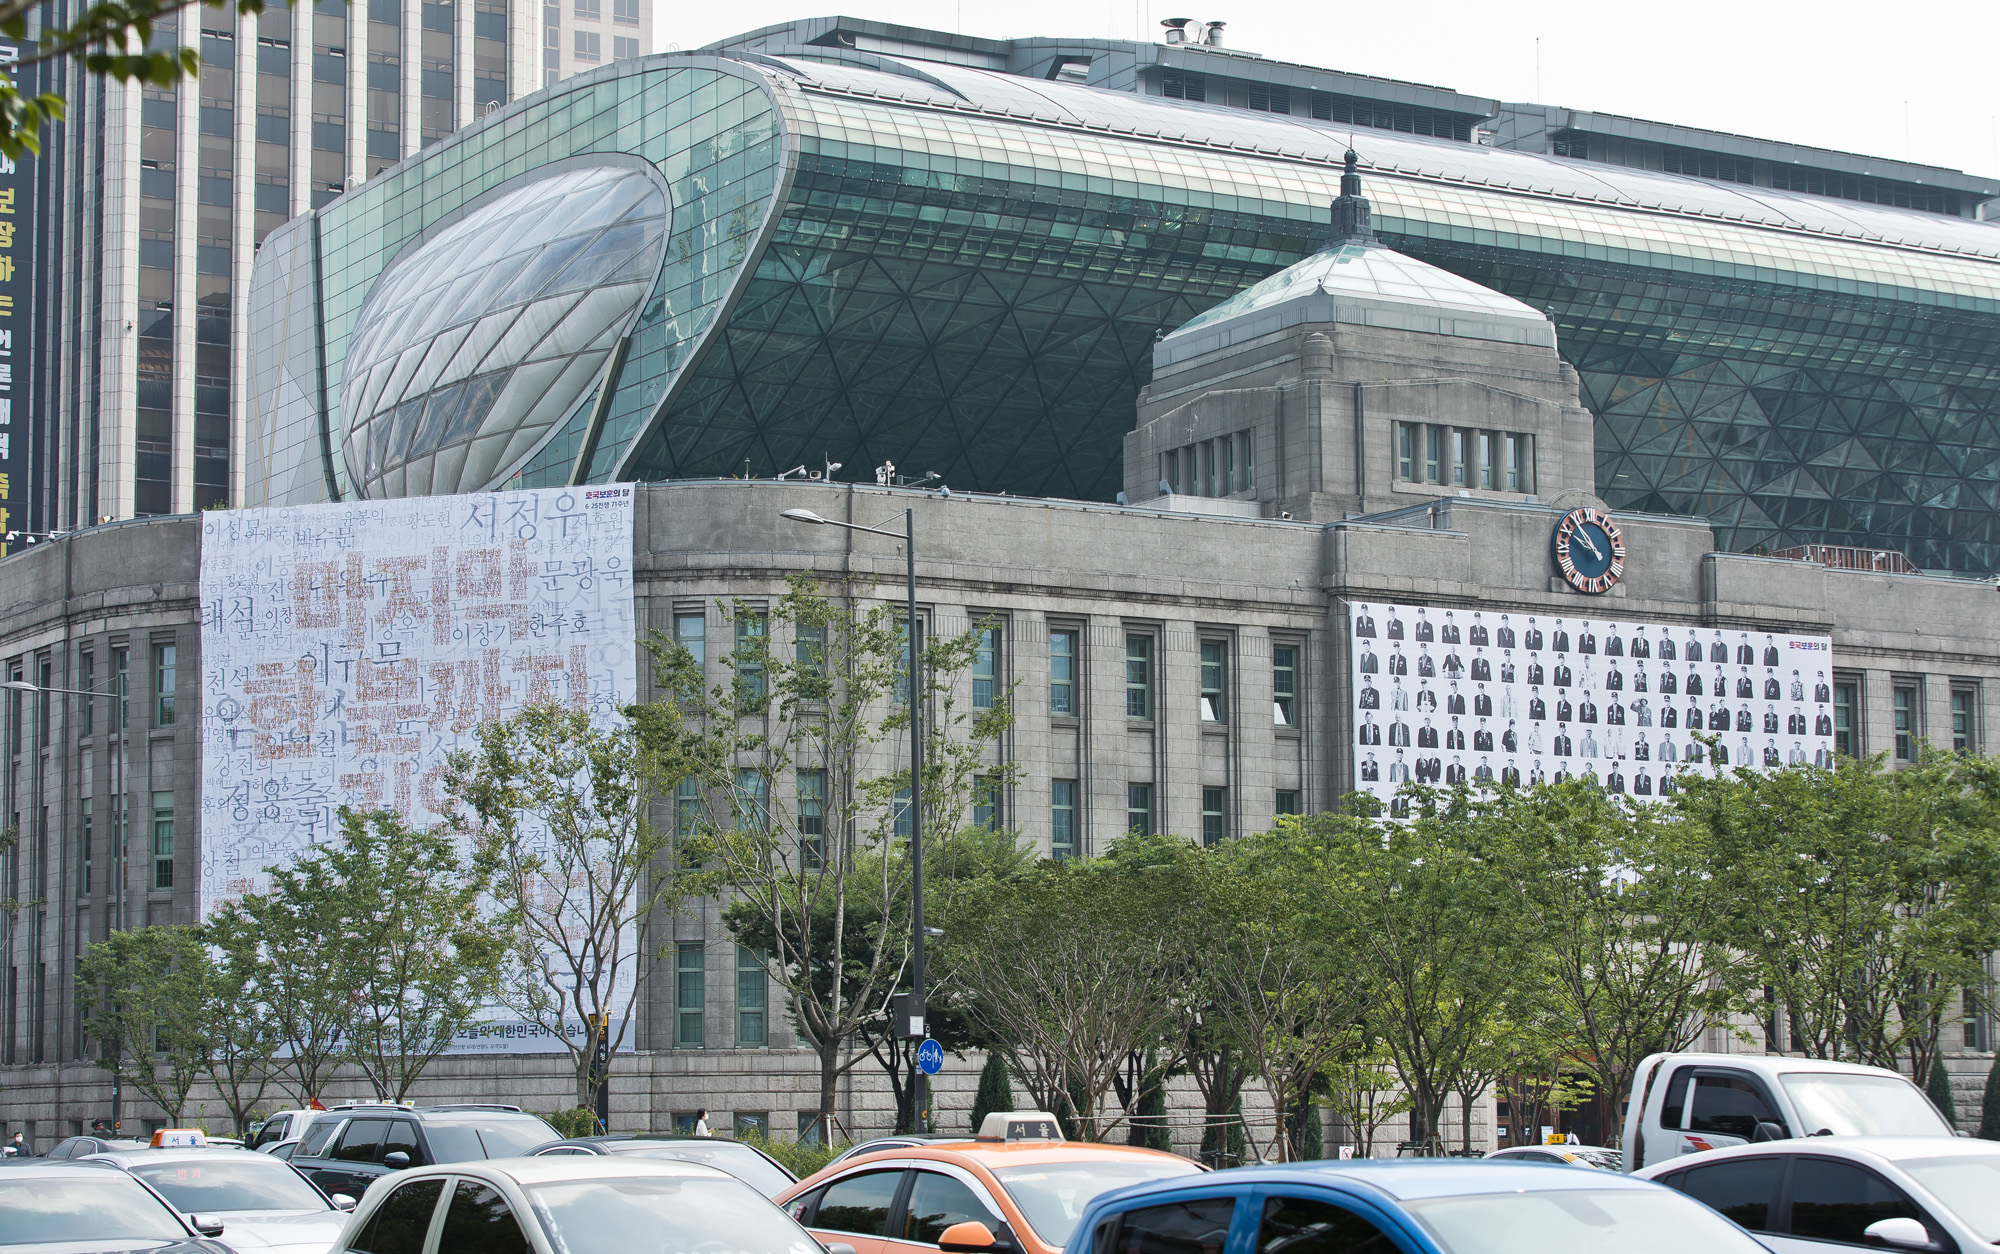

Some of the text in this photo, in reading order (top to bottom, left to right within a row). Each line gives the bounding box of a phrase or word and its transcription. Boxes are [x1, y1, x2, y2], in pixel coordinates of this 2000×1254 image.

[585, 488, 630, 500] 호국보훈의 달
[460, 491, 588, 543] 서정우
[540, 556, 629, 591] 문광욱
[293, 540, 538, 652] 마지막
[453, 621, 512, 646] 이창기
[529, 613, 590, 638] 한주호
[1789, 641, 1828, 651] 호국보훈의 달
[243, 657, 325, 761] 한
[600, 1043, 606, 1061] 시청
[171, 1135, 198, 1146] 서울
[1015, 1123, 1050, 1137] 서울
[176, 1167, 201, 1180] 빈차
